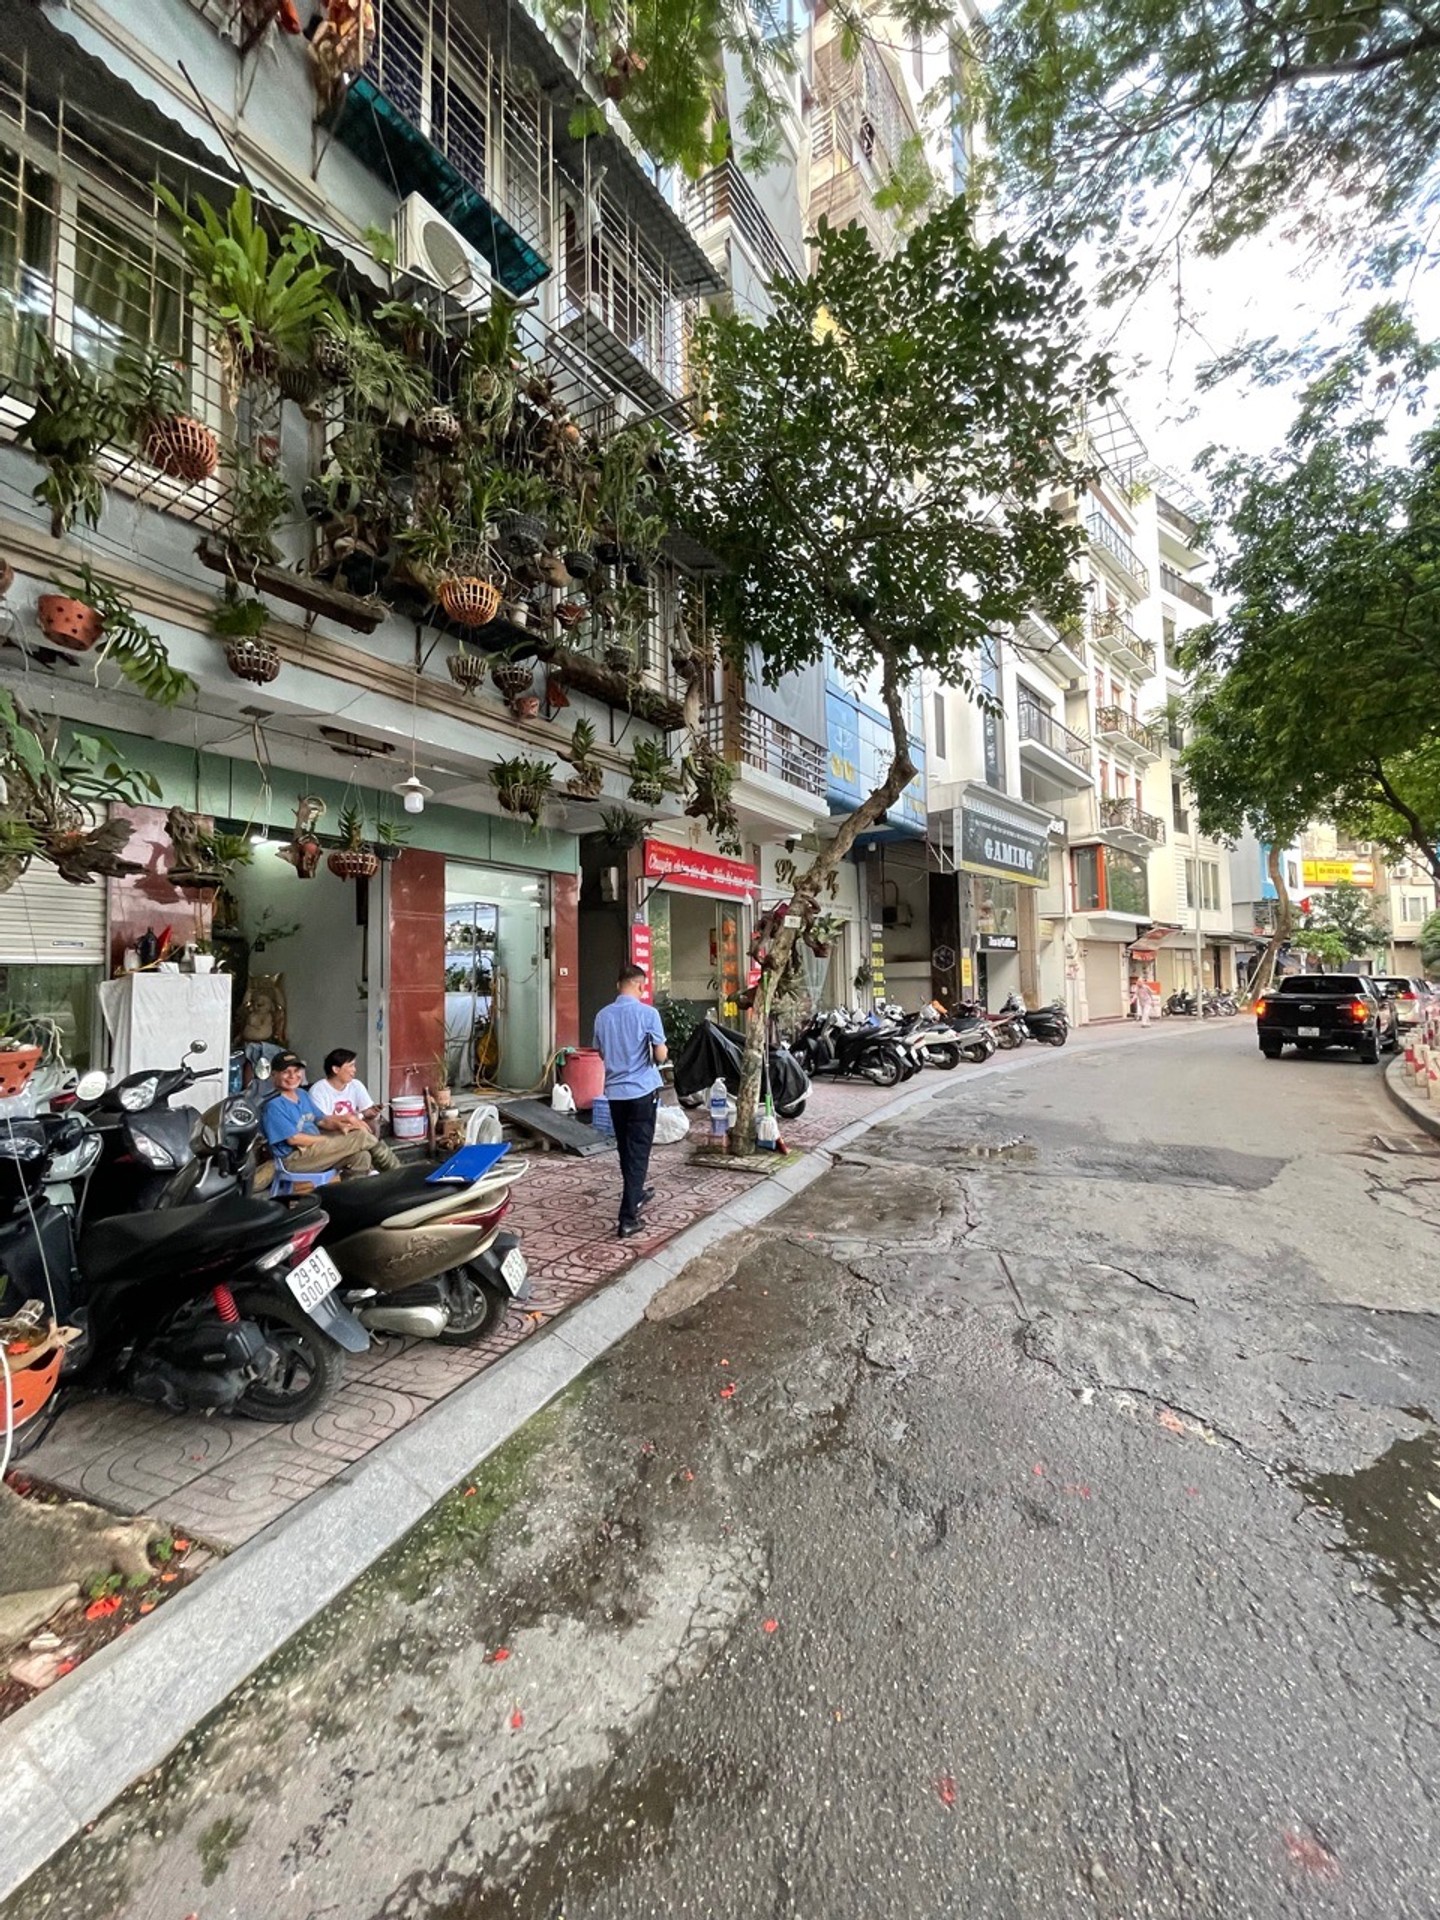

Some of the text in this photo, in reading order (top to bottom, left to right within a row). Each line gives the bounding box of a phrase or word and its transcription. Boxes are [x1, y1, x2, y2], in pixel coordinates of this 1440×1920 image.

[984, 837, 1033, 870] GAMING
[294, 1254, 326, 1289] 29-B1
[300, 1267, 337, 1307] 900.76
